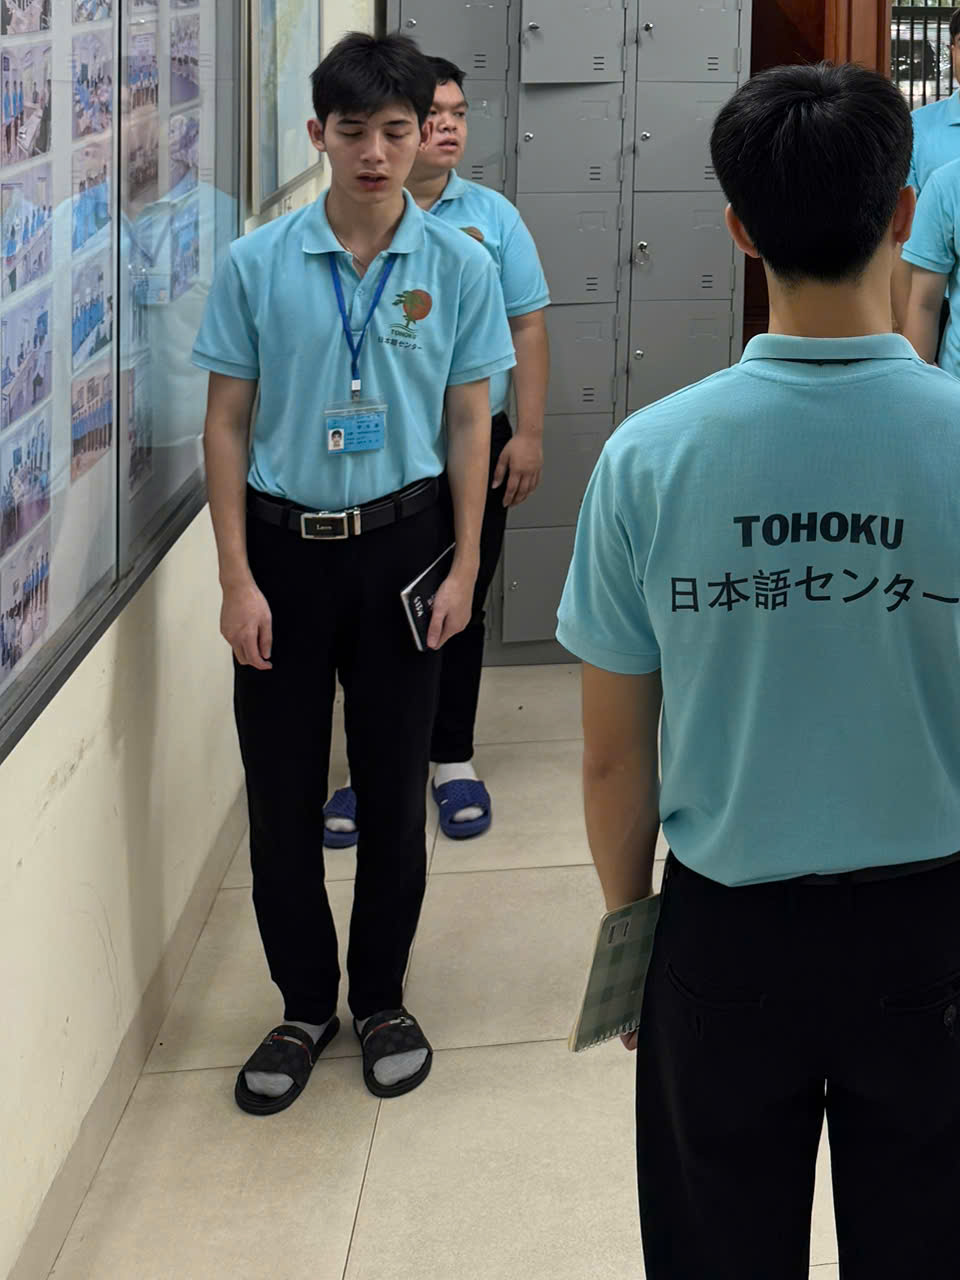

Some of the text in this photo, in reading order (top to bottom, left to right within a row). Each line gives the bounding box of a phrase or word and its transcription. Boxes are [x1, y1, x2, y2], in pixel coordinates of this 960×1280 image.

[733, 511, 904, 550] TOHOKU
[671, 566, 960, 612] 日本語センター
